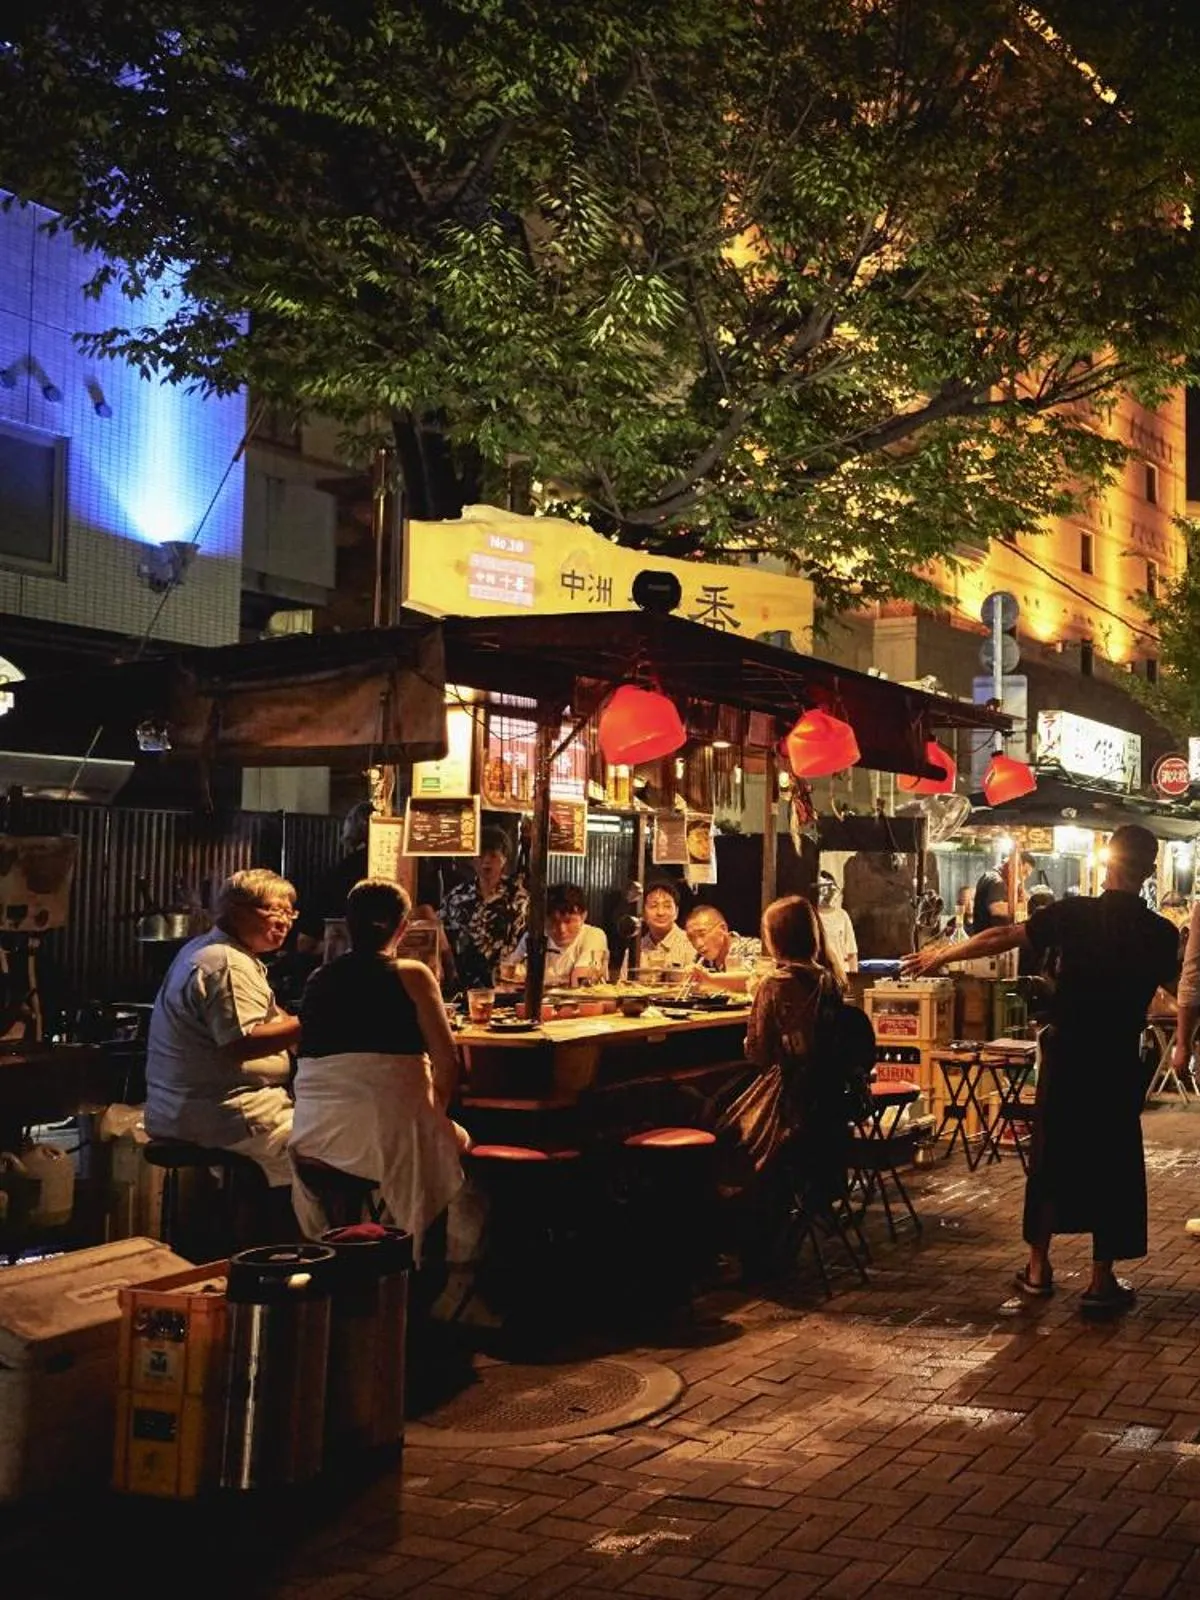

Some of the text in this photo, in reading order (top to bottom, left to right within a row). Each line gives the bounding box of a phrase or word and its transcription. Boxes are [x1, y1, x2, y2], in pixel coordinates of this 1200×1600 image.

[561, 568, 741, 632] 中洲番
[878, 1066, 914, 1081] KIRIN
